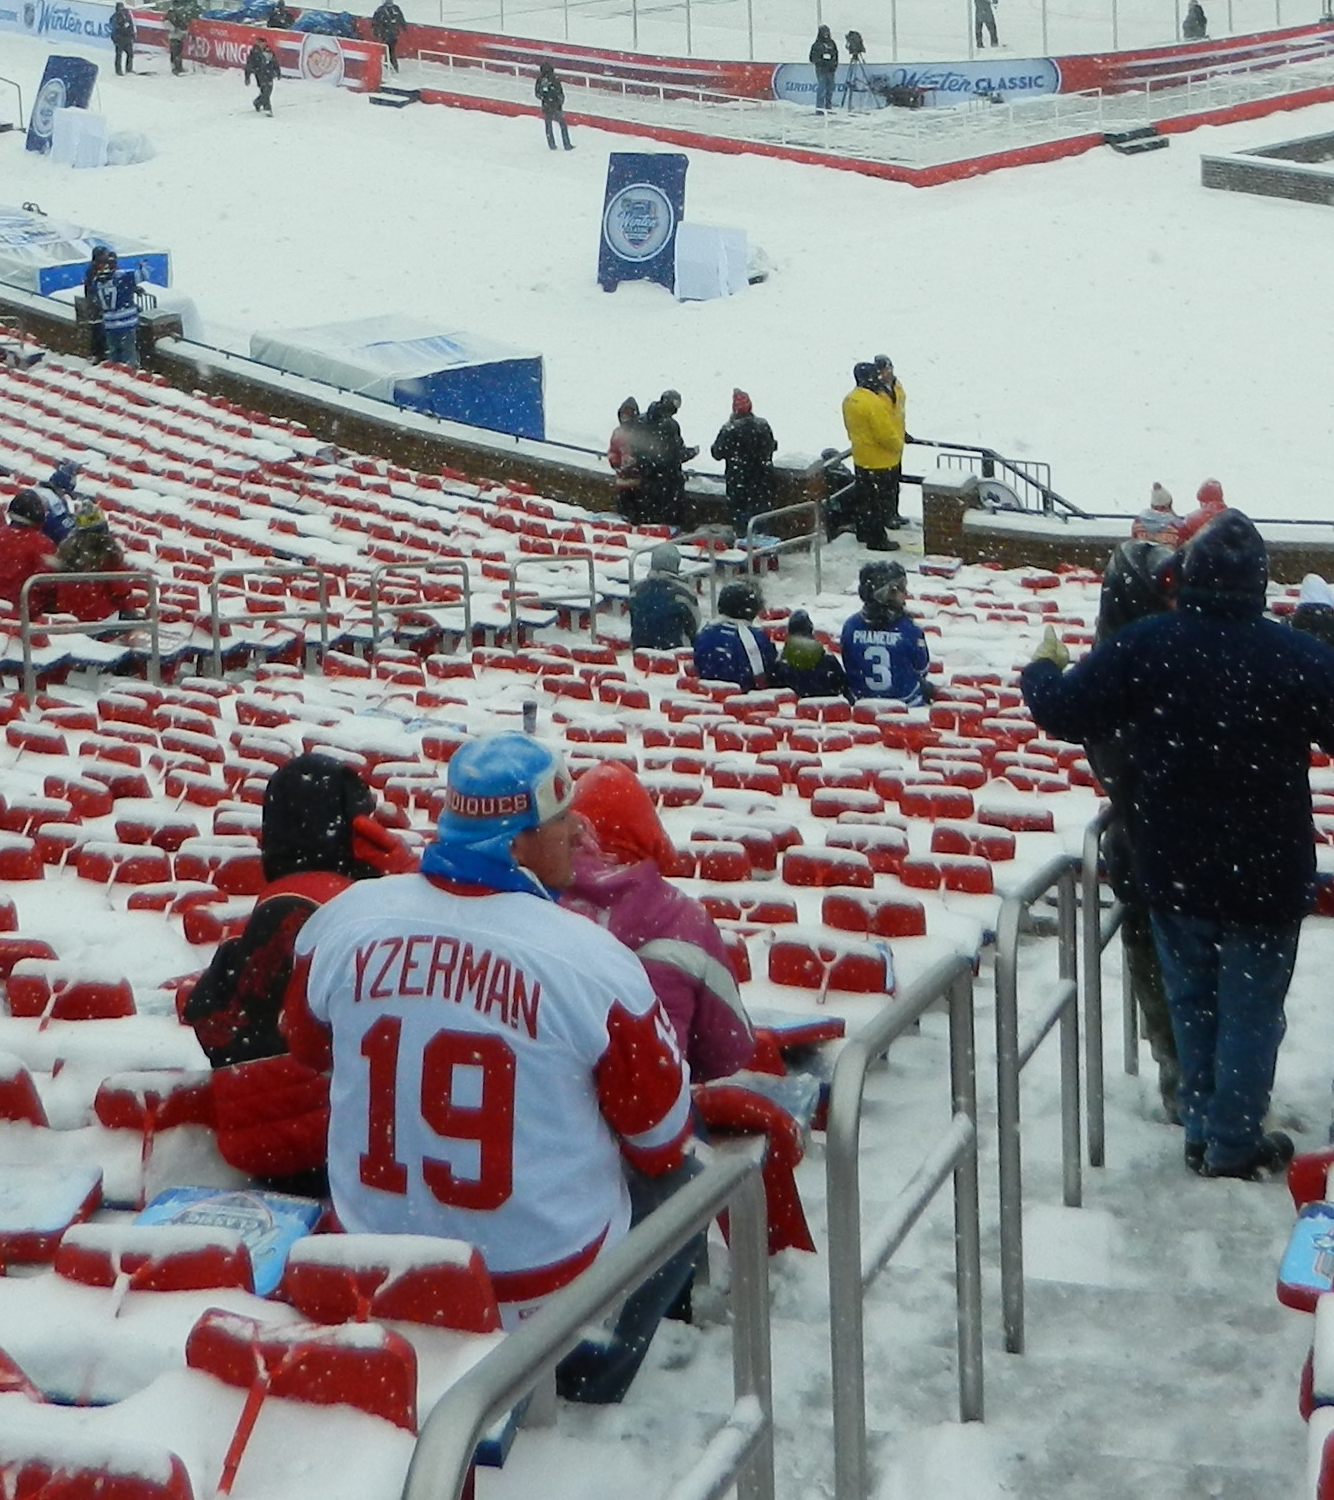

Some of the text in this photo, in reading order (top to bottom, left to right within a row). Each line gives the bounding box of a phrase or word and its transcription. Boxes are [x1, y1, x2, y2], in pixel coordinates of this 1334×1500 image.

[84, 19, 115, 39] CLAS
[187, 34, 211, 58] RED
[975, 74, 1044, 93] CLASSIC
[852, 630, 903, 647] PHANEUF
[863, 645, 893, 692] 3
[353, 934, 542, 1041] YZERMAN
[359, 1013, 518, 1212] 19
